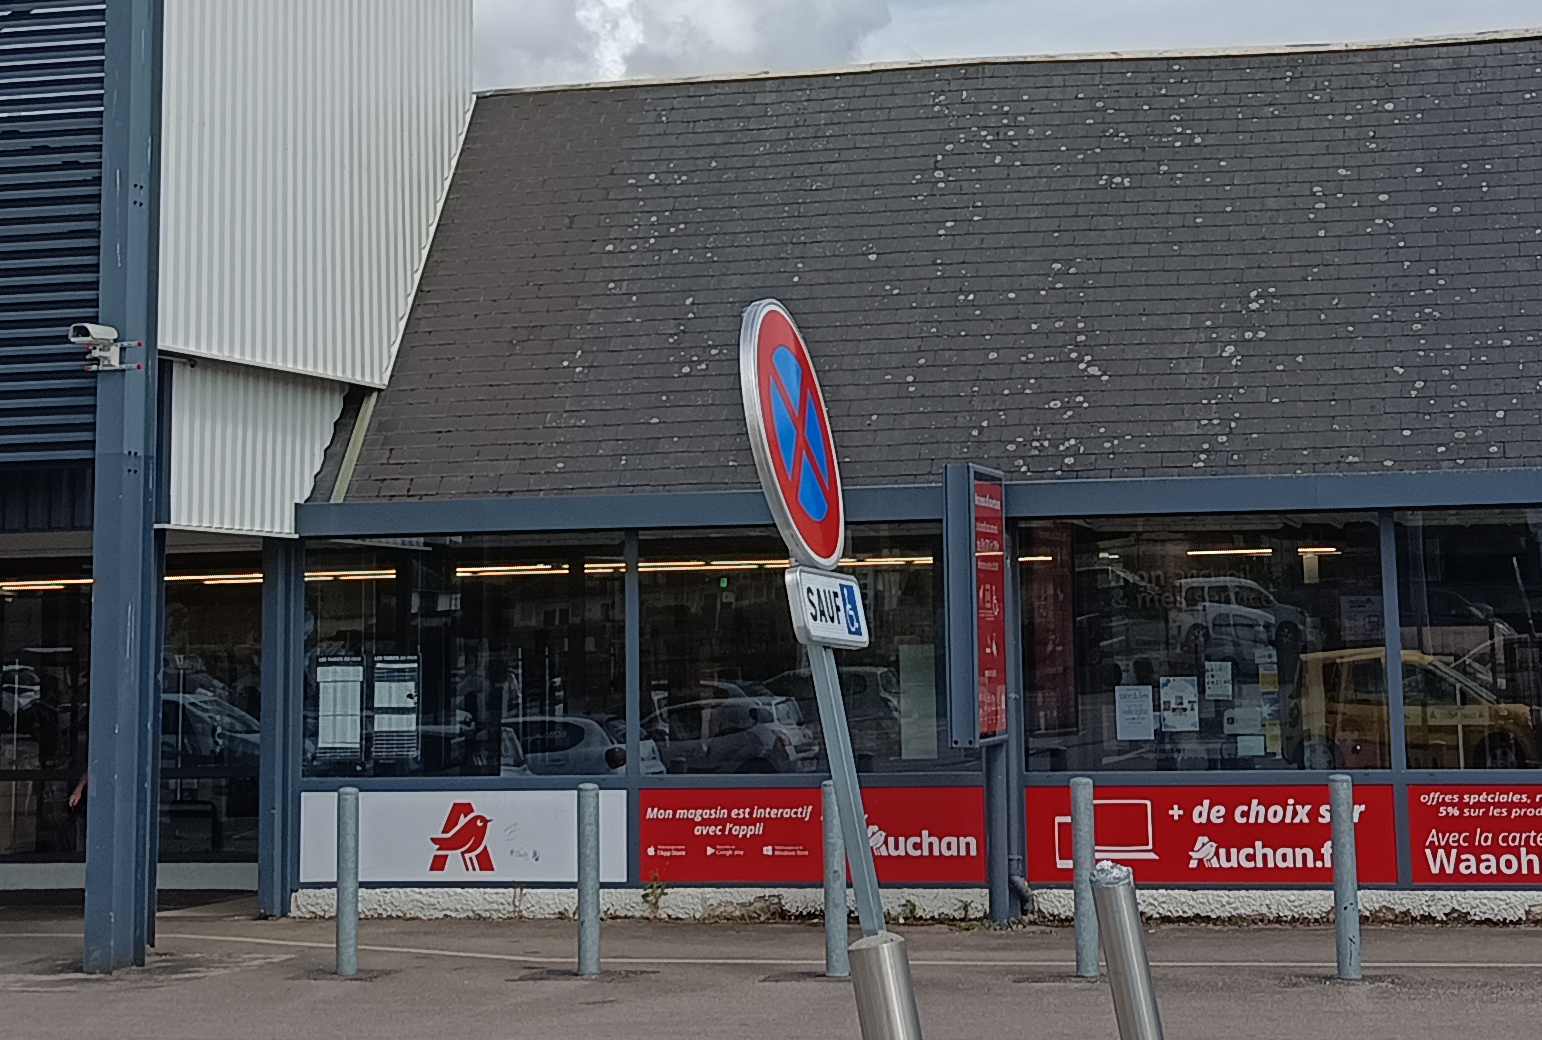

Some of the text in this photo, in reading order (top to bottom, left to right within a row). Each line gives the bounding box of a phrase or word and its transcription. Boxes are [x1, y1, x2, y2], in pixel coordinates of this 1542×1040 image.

[807, 586, 841, 625] SAUF
[1420, 792, 1459, 805] offres
[1462, 791, 1532, 805] spéciales,
[646, 805, 813, 822] Mon magasin est interactif
[1192, 799, 1226, 823] de
[1234, 798, 1310, 823] choix
[1317, 803, 1366, 823] sr
[1438, 805, 1460, 816] 5%
[1463, 807, 1486, 817] sur
[1489, 805, 1508, 817] les
[694, 822, 764, 838] avec l'appli
[1425, 828, 1469, 847] Avec
[1475, 827, 1495, 847] la
[867, 825, 977, 856] Auchan
[1188, 835, 1333, 869] Auchan.f
